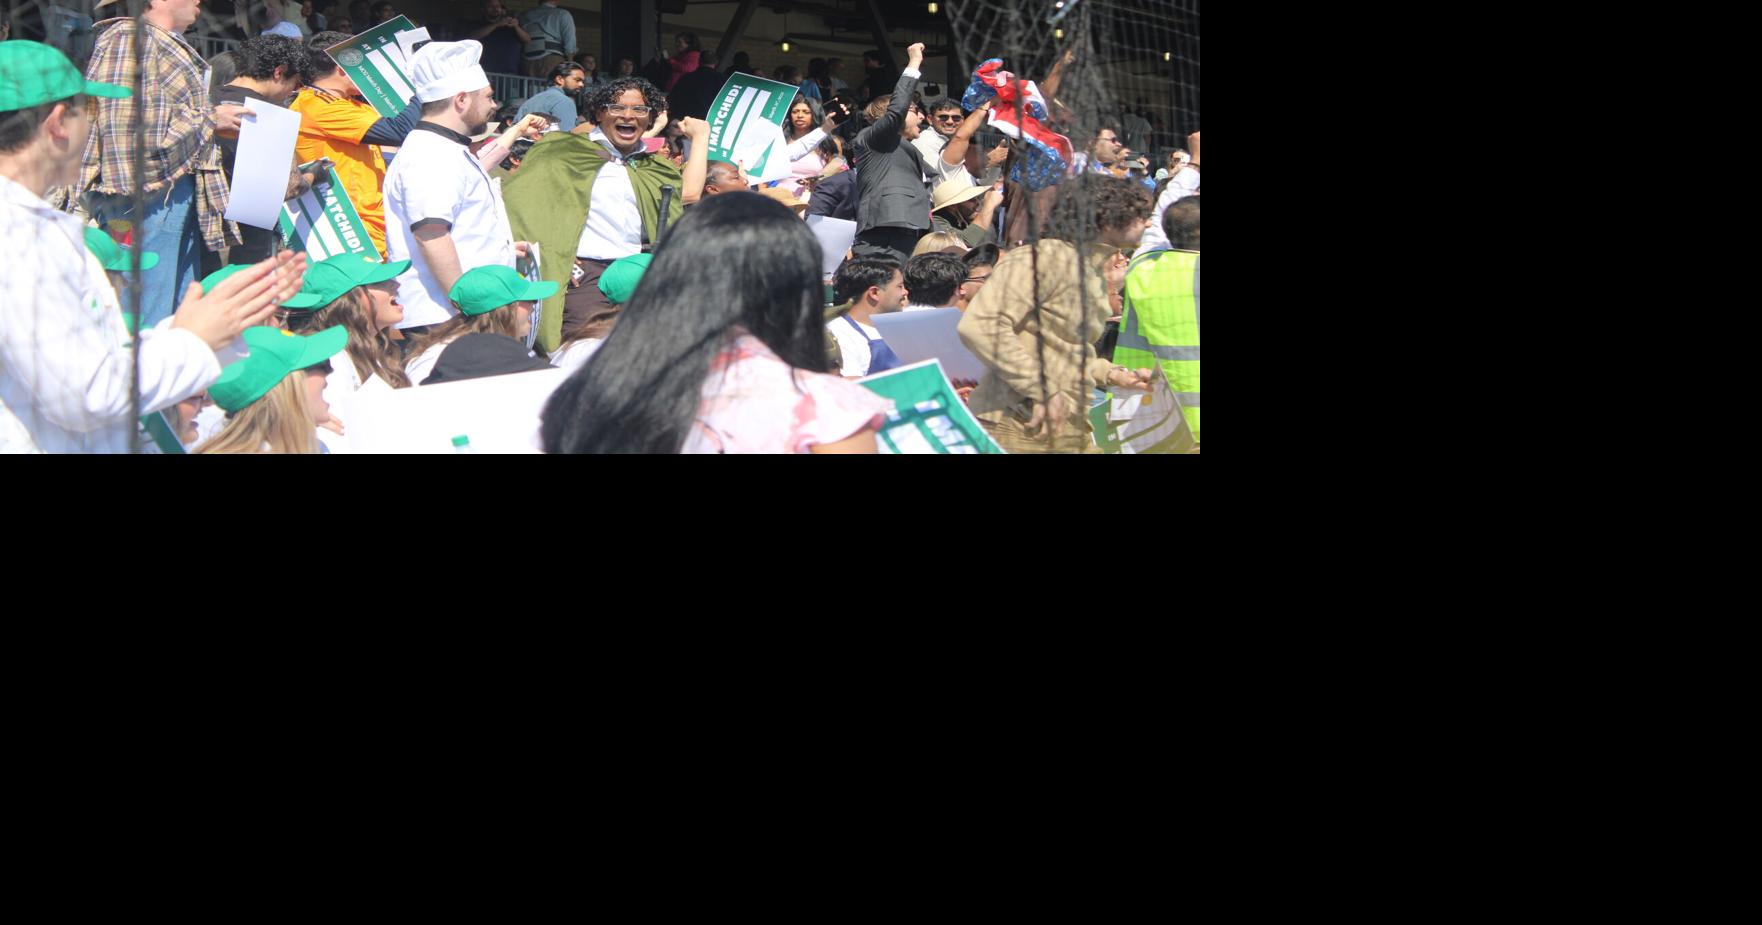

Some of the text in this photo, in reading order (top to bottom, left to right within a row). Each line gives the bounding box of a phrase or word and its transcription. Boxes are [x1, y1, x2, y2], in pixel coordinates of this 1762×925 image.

[361, 43, 372, 51] AT
[709, 84, 743, 147] MATCHED!
[316, 181, 366, 254] MATCHED!
